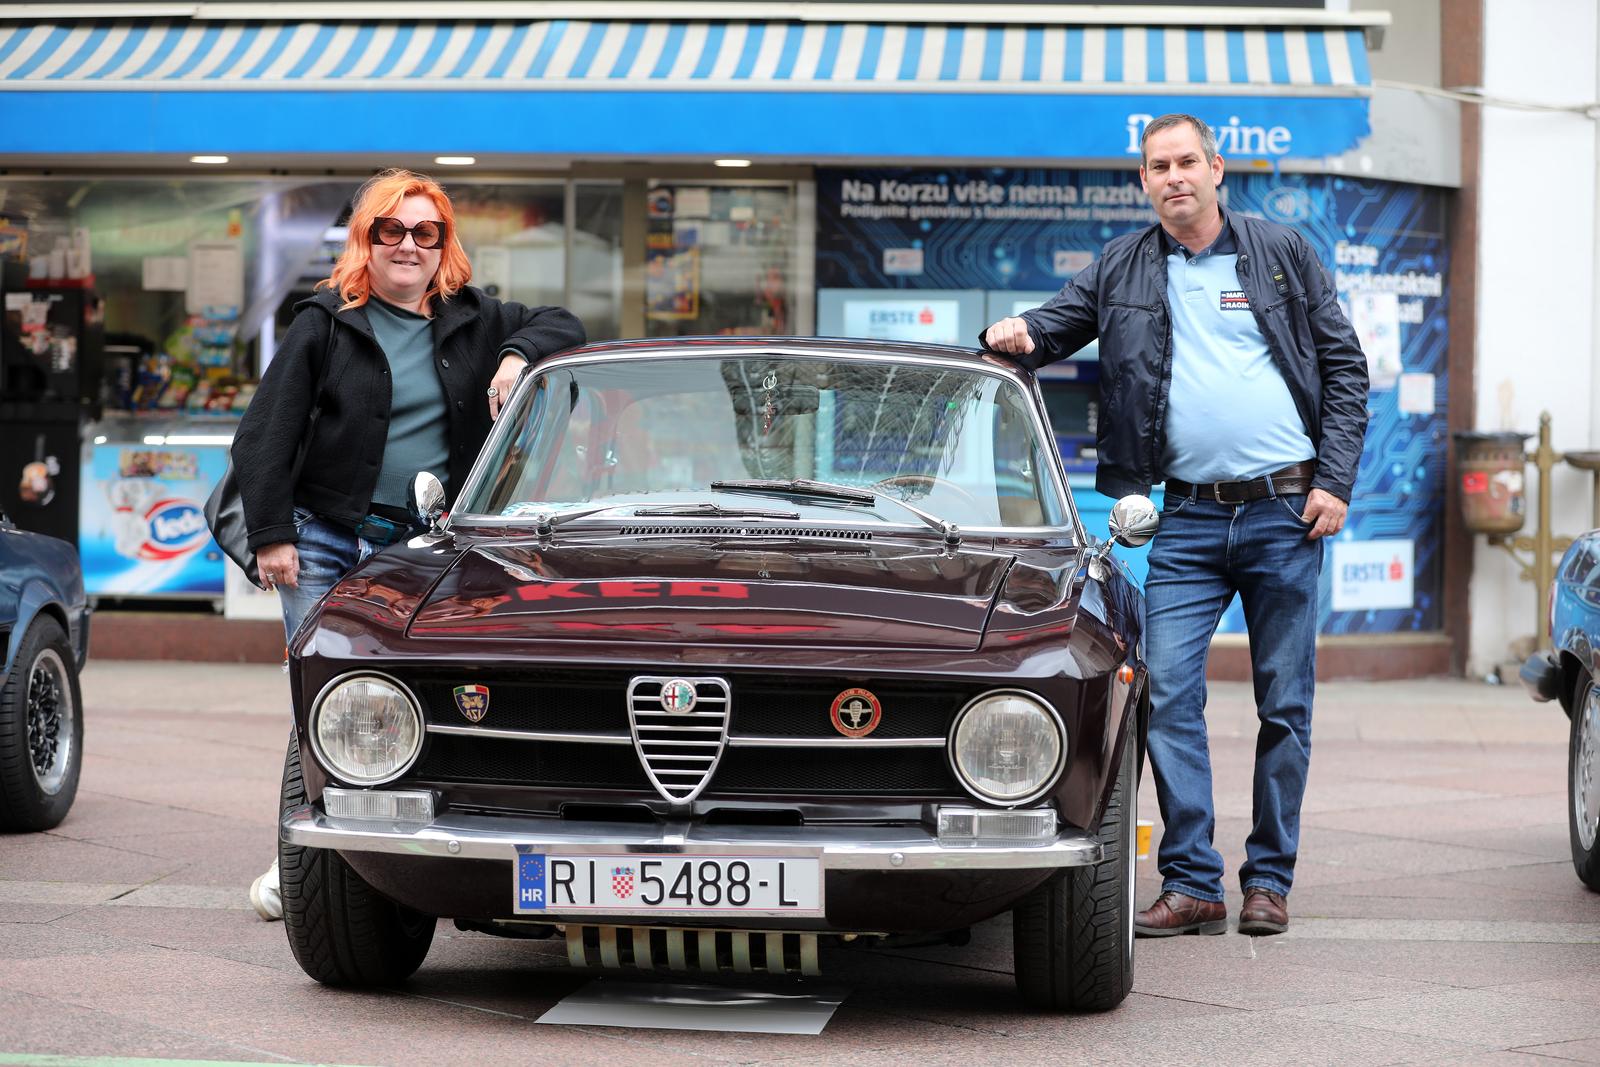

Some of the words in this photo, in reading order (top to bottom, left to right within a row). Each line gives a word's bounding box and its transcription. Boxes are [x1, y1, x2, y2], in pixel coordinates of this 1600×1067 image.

[1126, 114, 1291, 155] ivine
[841, 179, 875, 201] Na
[880, 180, 948, 202] Korzu
[953, 181, 1004, 203] više
[1008, 184, 1077, 204] nema
[1335, 240, 1378, 266] Erste
[869, 310, 915, 325] ERSTE
[1342, 562, 1385, 583] ERSTE
[521, 888, 543, 902] HR
[551, 860, 595, 904] RI
[640, 860, 798, 906] 5488-L
